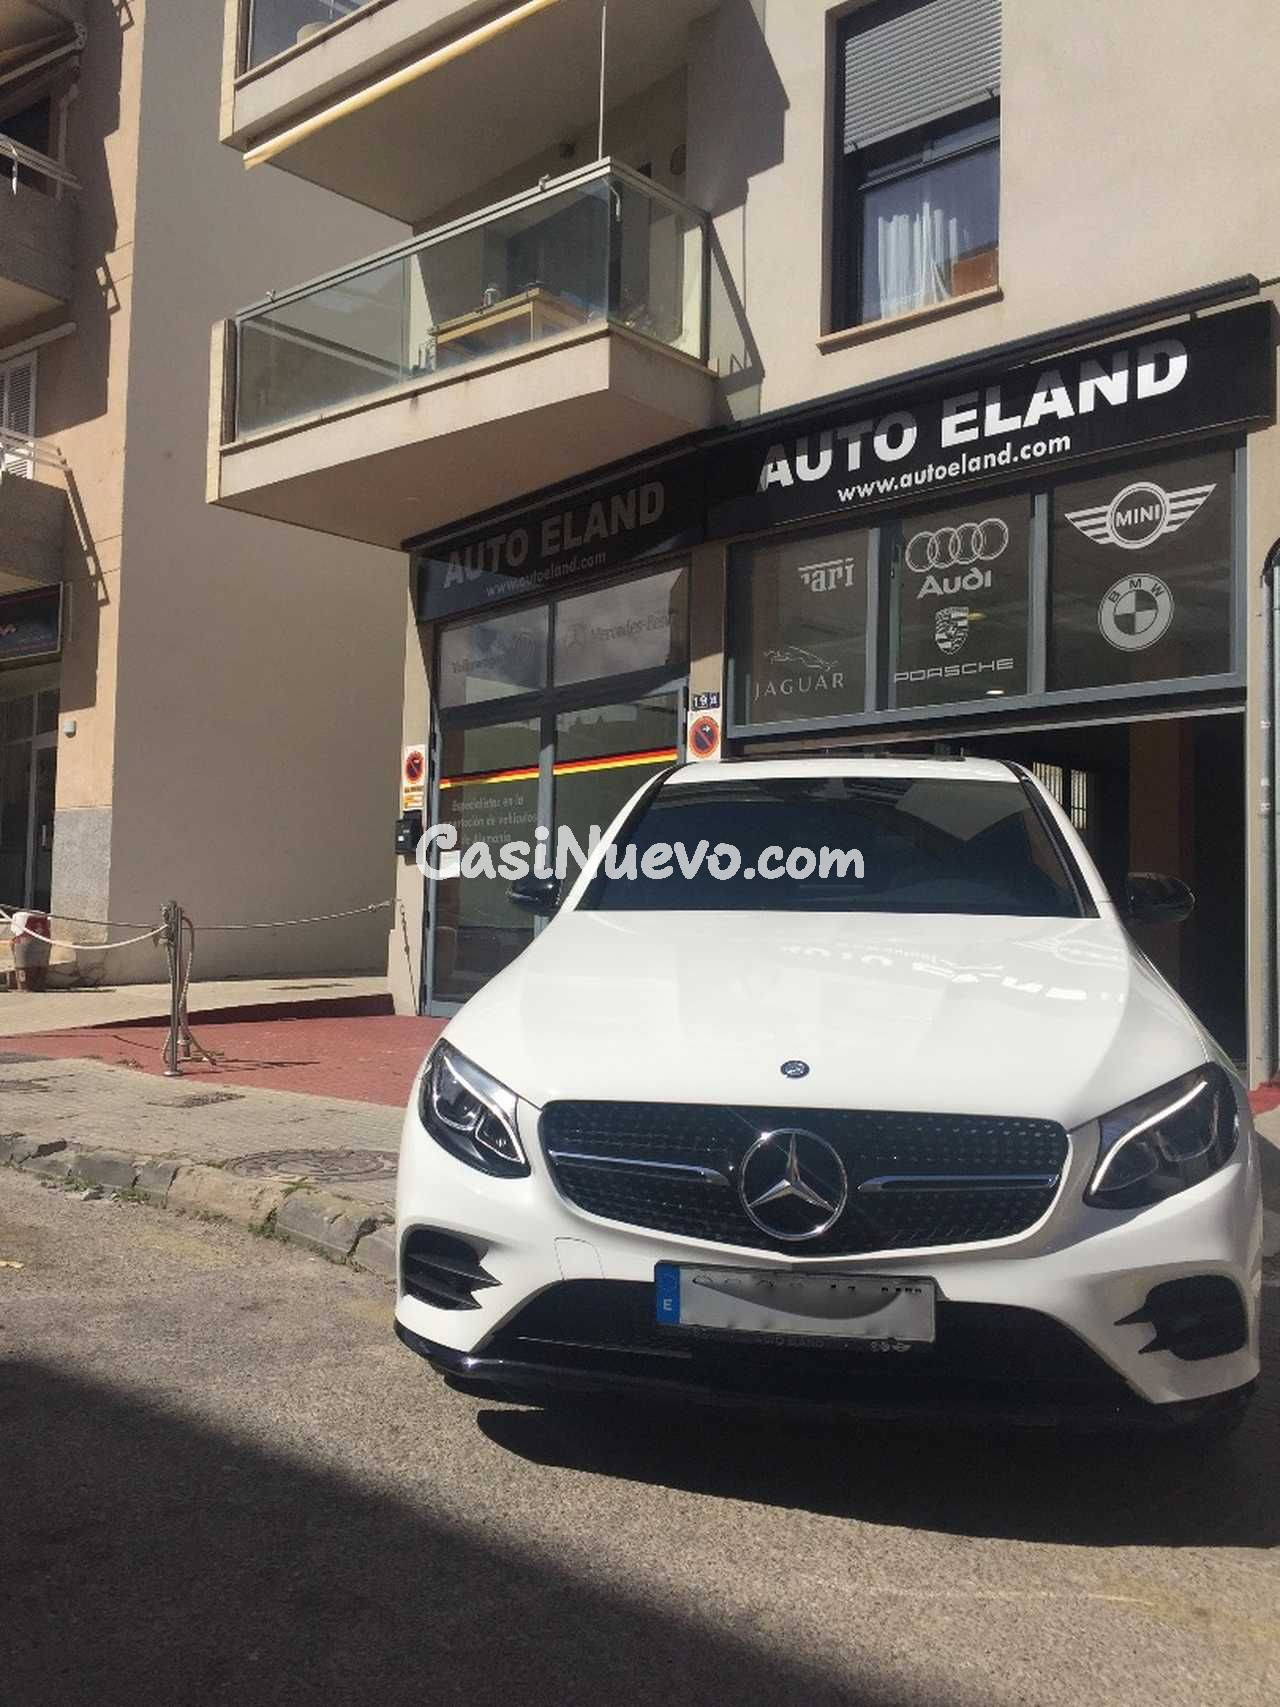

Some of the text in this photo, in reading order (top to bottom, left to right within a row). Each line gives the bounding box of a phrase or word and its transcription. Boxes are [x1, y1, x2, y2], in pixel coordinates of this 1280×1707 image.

[756, 338, 1189, 493] AUTO ELAND
[836, 431, 1072, 503] www.autoeland.com
[1115, 503, 1160, 528] MINI
[443, 480, 666, 589] AUTO ELAND
[485, 551, 608, 598] www.autoeland.com
[916, 567, 992, 599] Audi
[1107, 577, 1165, 604] BMW
[894, 657, 1014, 683] PORSCHE
[753, 672, 844, 702] JAGUAR
[663, 1298, 673, 1311] E
